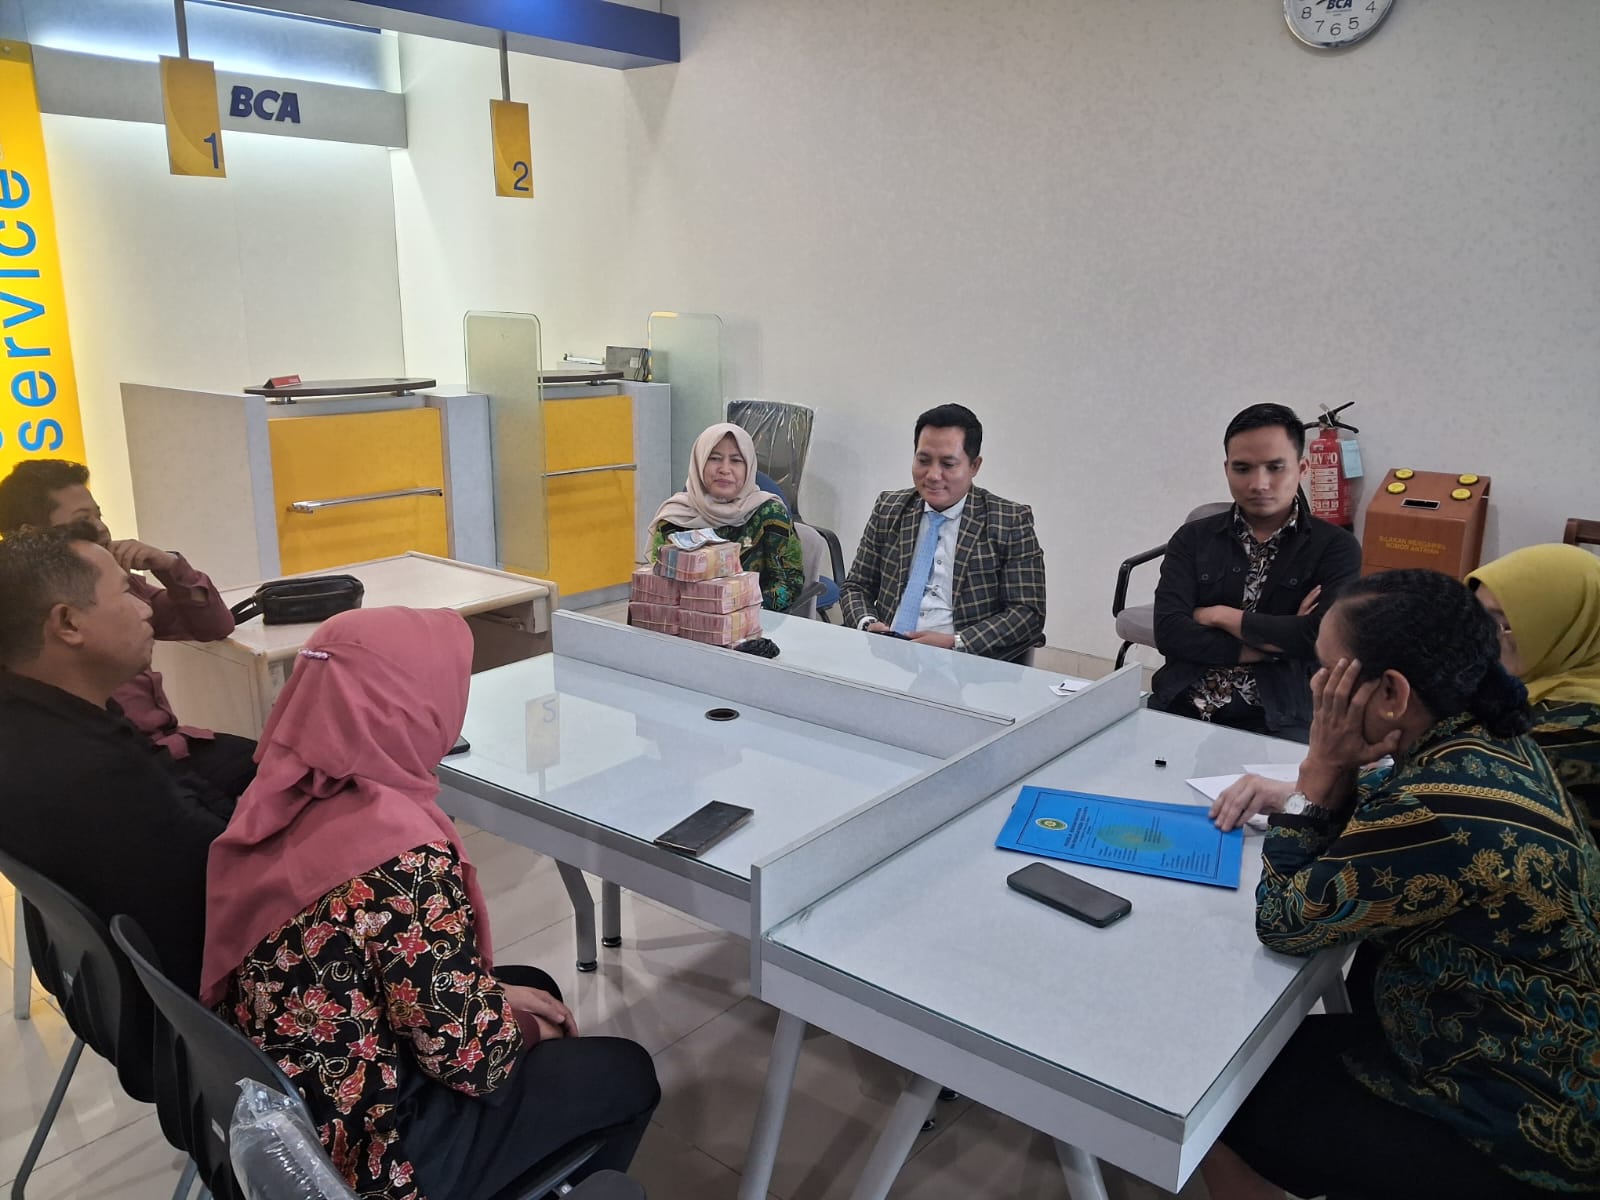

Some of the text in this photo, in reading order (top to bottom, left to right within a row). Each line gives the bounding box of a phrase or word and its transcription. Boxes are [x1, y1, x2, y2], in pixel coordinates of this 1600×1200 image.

[1326, 0, 1352, 9] BCA
[1365, 1, 1376, 13] 4
[1301, 6, 1312, 19] 8
[1315, 20, 1325, 33] 7
[1330, 23, 1341, 36] 6
[1348, 17, 1359, 30] 5
[229, 85, 301, 124] BCA
[203, 132, 219, 169] 1
[513, 161, 529, 191] 2
[0, 168, 64, 452] service
